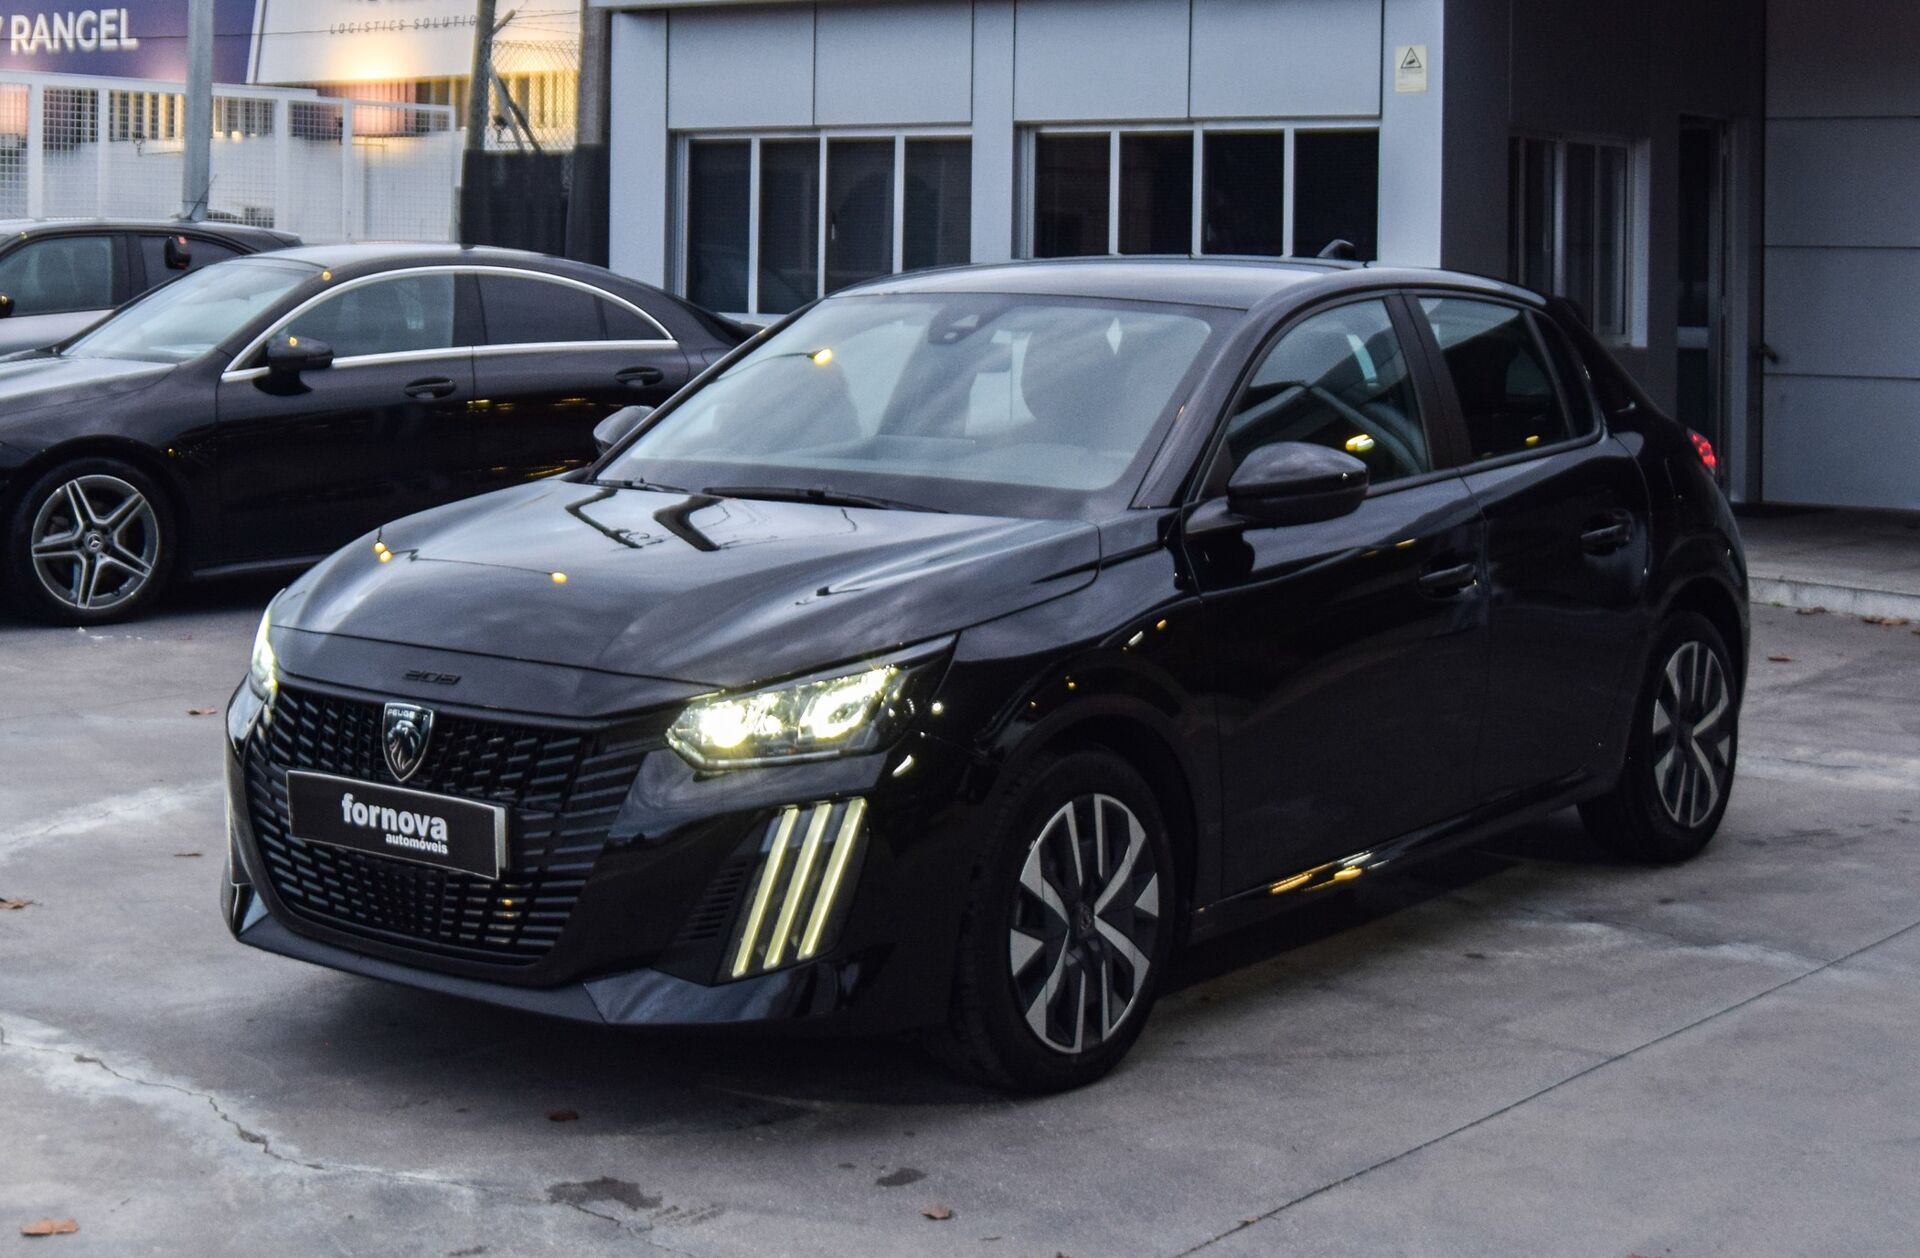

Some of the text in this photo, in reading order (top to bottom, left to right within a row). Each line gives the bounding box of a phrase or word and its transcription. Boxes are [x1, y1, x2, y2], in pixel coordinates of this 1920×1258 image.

[10, 8, 138, 54] RANGEL
[330, 14, 477, 34] LOGISTICS SOLUTIO
[402, 669, 461, 685] 208
[341, 793, 448, 841] fornova
[385, 833, 448, 855] automóveis
